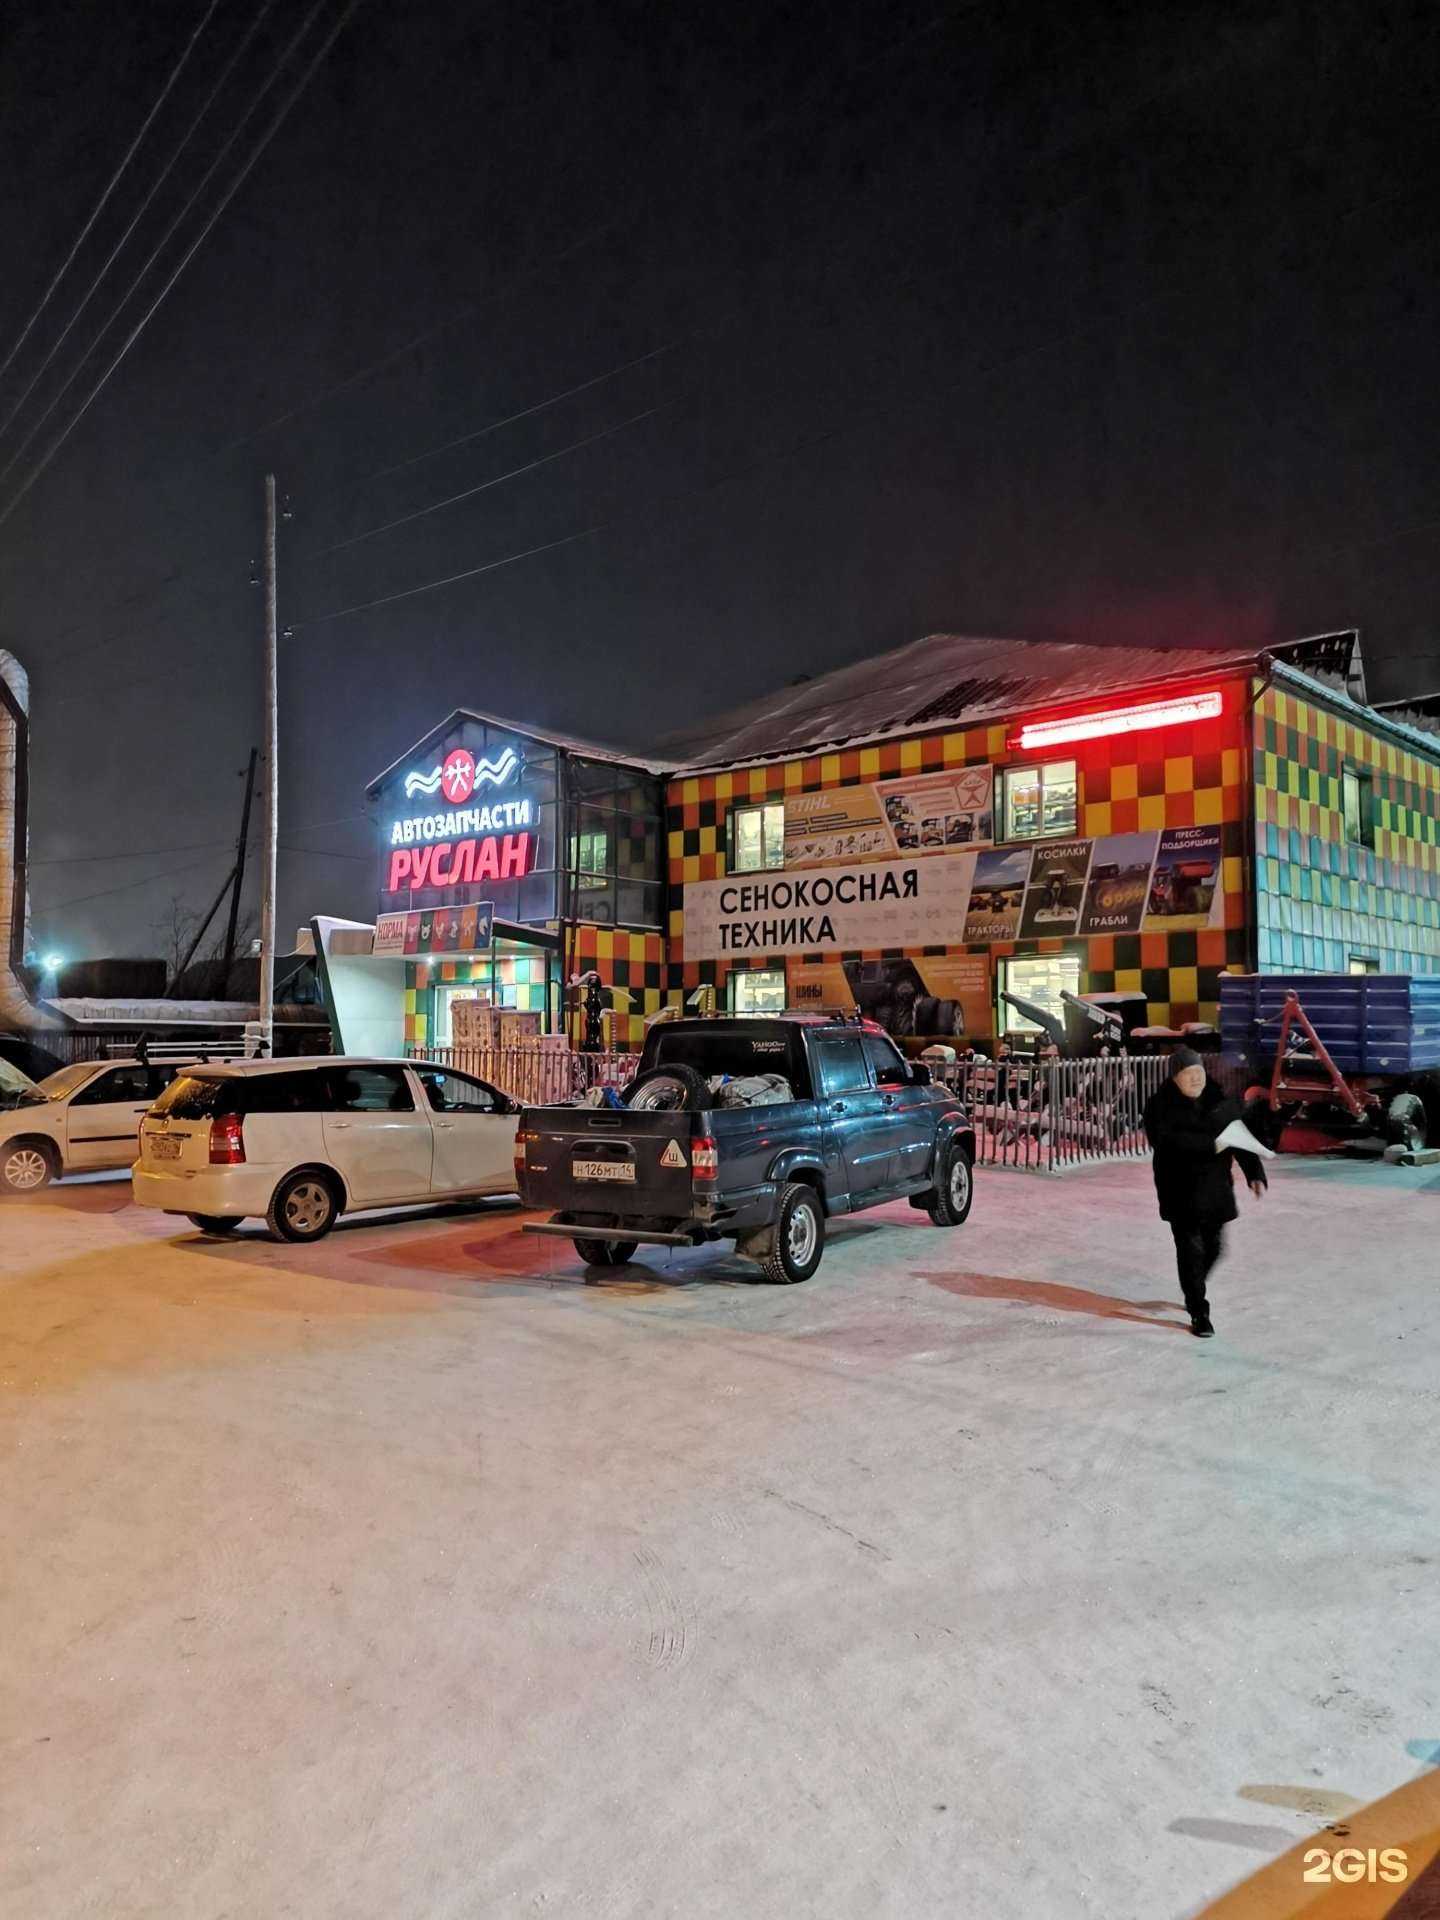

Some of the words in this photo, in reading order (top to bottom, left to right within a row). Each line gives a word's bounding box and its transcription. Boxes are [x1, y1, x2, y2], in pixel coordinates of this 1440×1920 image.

[391, 799, 529, 844] АВТОЗАПЧАСТИ
[1037, 846, 1087, 861] КОСИЛКИ
[1161, 837, 1220, 850] ПОДБОРЩИКИ
[389, 832, 529, 892] РУСЛАН
[719, 869, 918, 914] СЕНОКОСНАЯ
[718, 915, 837, 950] ТЕХНИКА
[967, 922, 1014, 937] ТРАКТОРЫ
[1089, 915, 1128, 928] ГРАБЛИ
